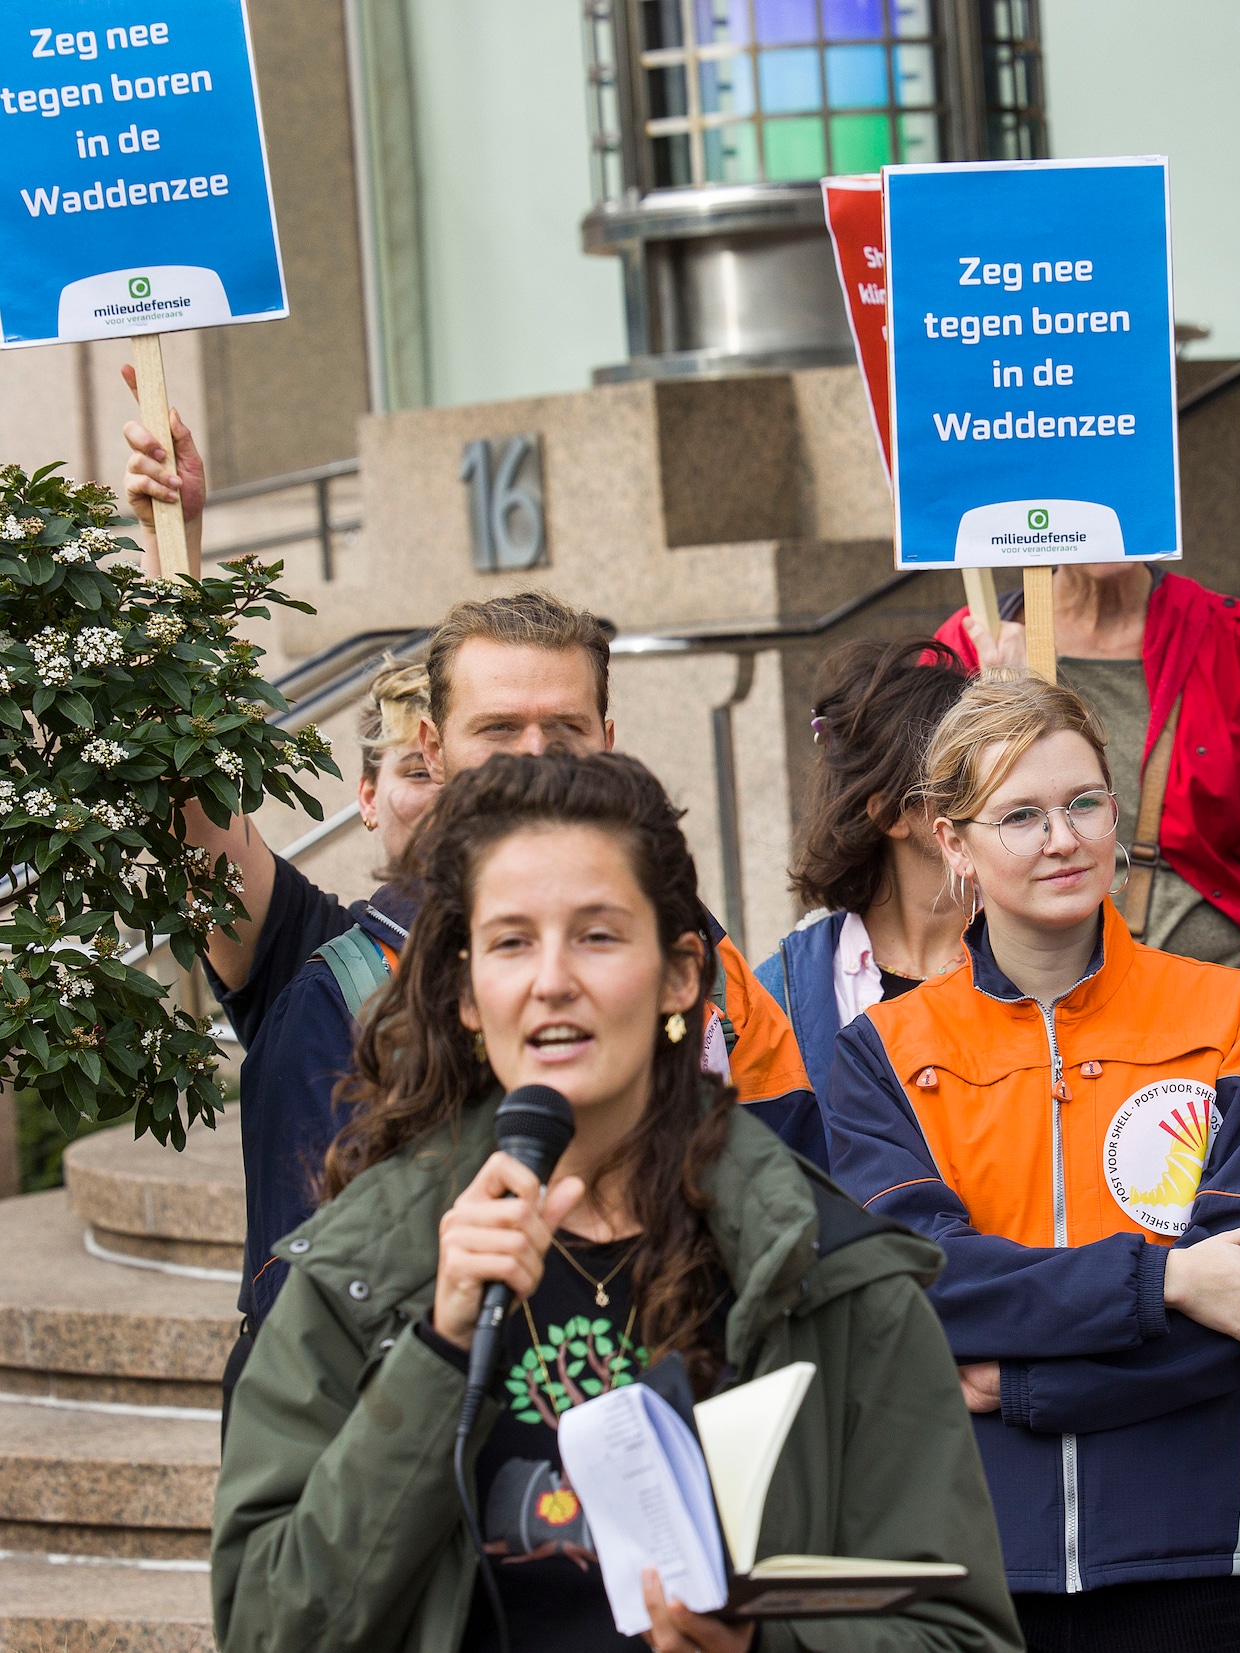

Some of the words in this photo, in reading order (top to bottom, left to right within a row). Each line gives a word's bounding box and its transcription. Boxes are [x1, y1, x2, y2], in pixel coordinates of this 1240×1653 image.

[29, 27, 98, 61] Zeg
[106, 22, 169, 50] nee
[0, 80, 103, 118] tegen
[110, 70, 213, 102] boren
[76, 130, 109, 159] in
[118, 124, 161, 154] de
[20, 174, 229, 217] Waddenzee
[959, 257, 1023, 292] Zeg
[1032, 260, 1093, 283] nee
[93, 296, 191, 318] milieudefensie
[104, 317, 125, 326] voor
[126, 310, 184, 324] veranderaars
[923, 312, 1023, 345] tegen
[1032, 306, 1130, 335] boren
[992, 359, 1023, 388] in
[1033, 358, 1074, 387] de
[932, 410, 1136, 442] Waddenzee
[457, 435, 545, 572] 16
[991, 531, 1087, 545] milieudefensie
[1001, 546, 1021, 554] voor
[1022, 544, 1078, 553] veranderaars
[1134, 1087, 1159, 1108] POST
[1161, 1083, 1193, 1094] VOOR
[1194, 1086, 1216, 1105] SHEL
[1112, 1110, 1133, 1140] SHELL
[1108, 1142, 1118, 1174] VOOR
[1110, 1177, 1130, 1203] POST
[1140, 1211, 1170, 1230] SHELL
